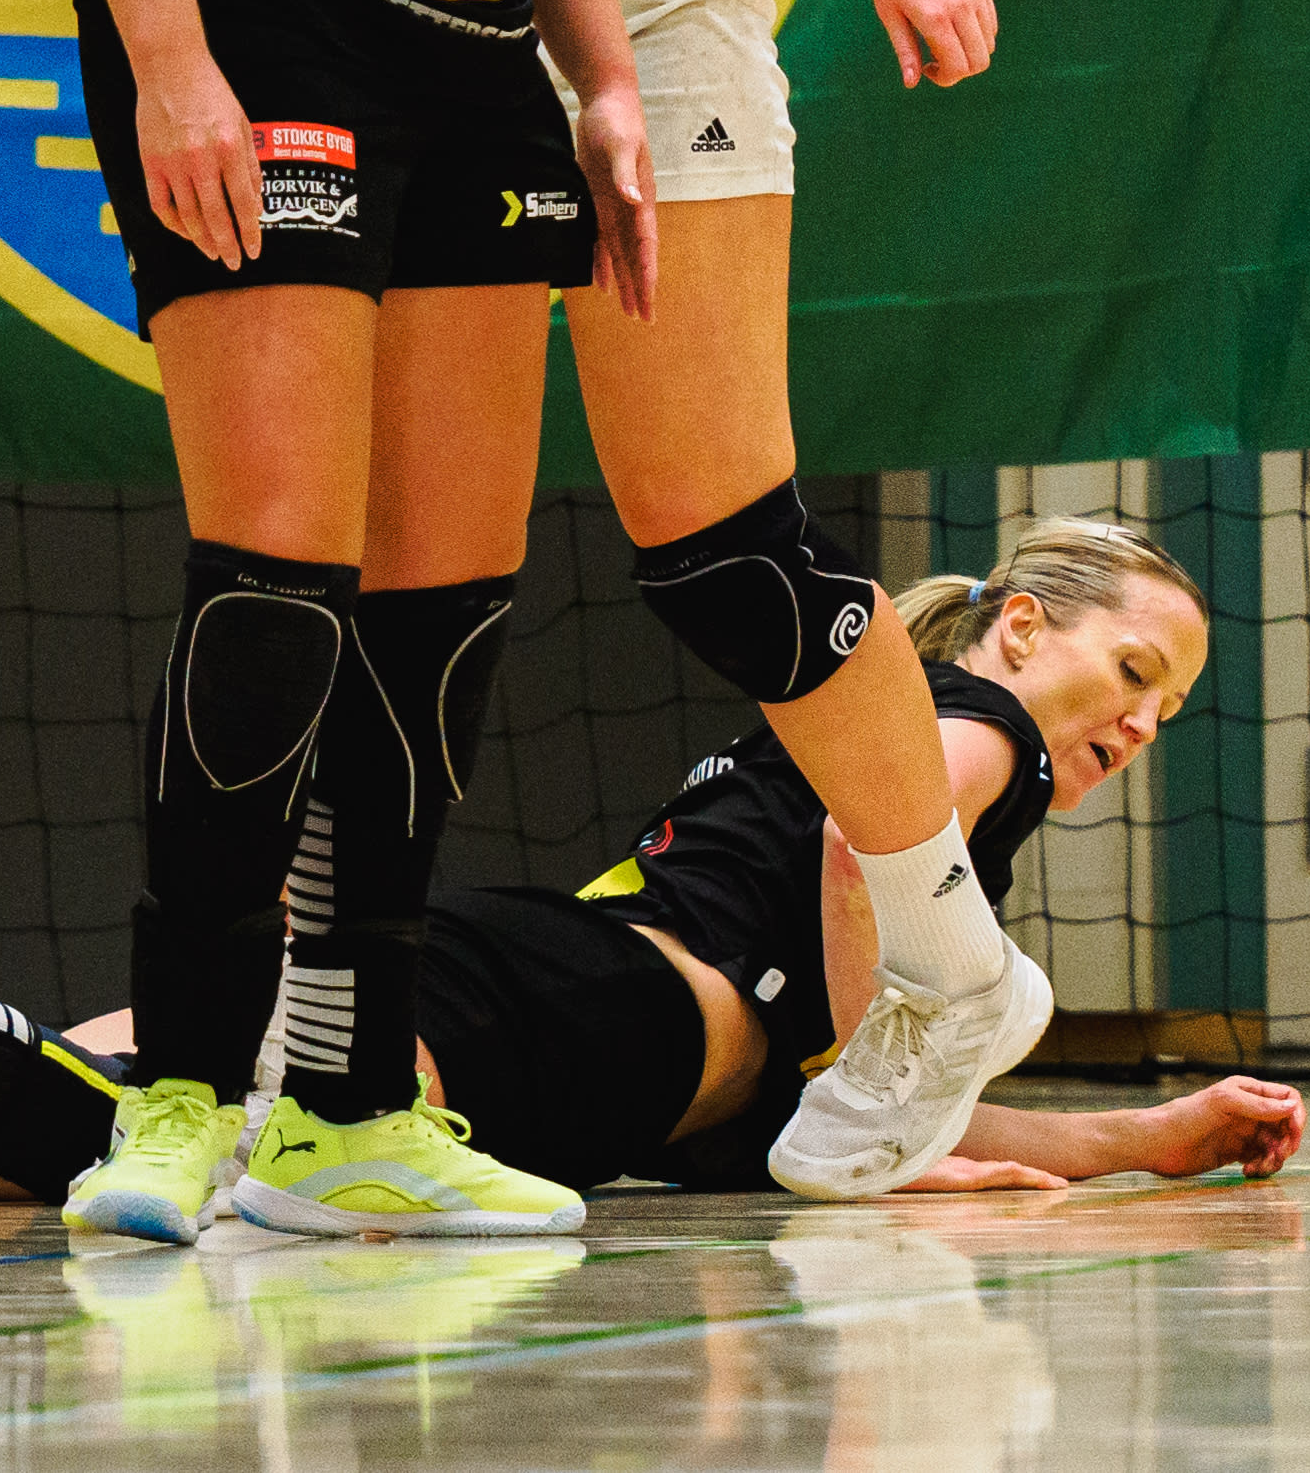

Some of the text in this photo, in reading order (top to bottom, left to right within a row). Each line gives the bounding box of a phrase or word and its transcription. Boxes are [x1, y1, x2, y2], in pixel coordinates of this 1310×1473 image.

[273, 128, 325, 147] STOKKE
[326, 132, 353, 155] BYGG
[691, 140, 736, 152] adidas
[330, 183, 341, 197] &
[268, 197, 340, 212] HAUGEN
[526, 192, 578, 220] Solberg
